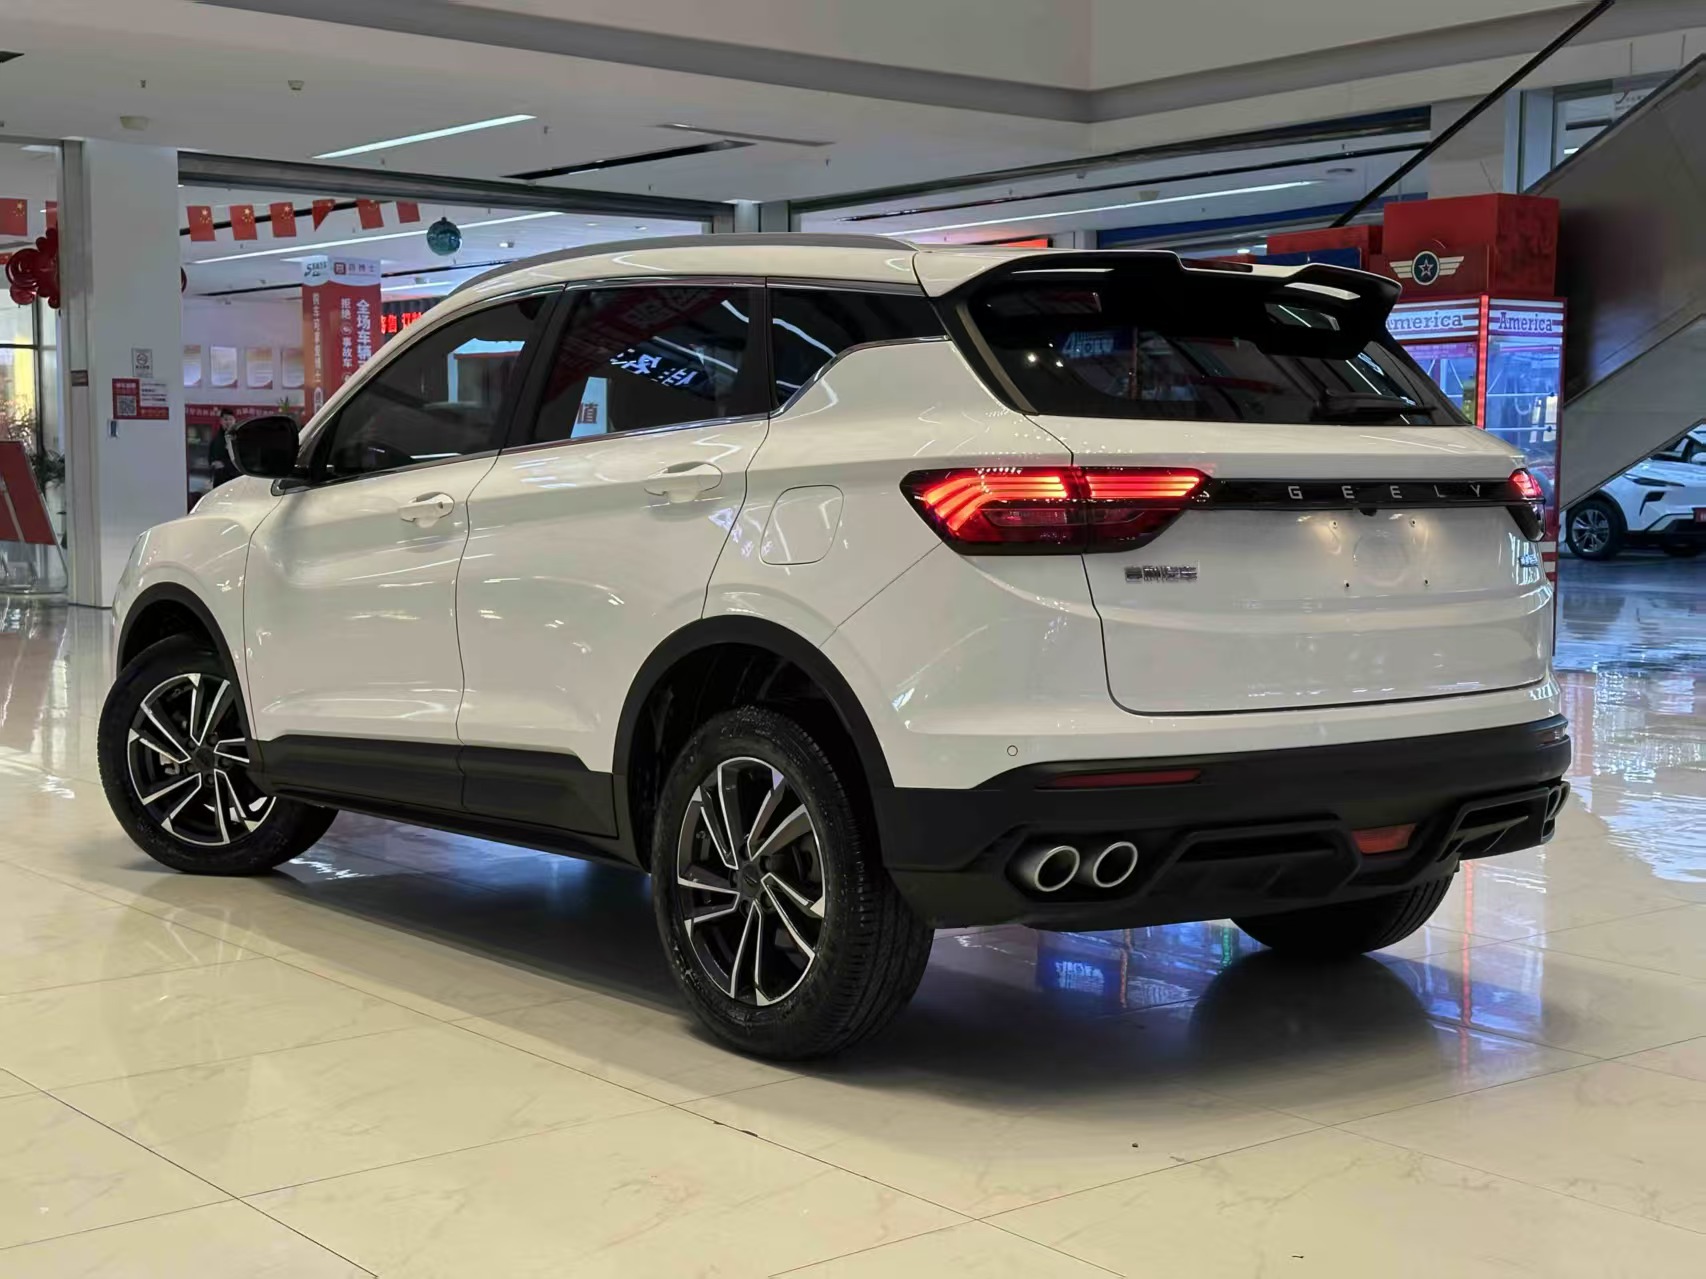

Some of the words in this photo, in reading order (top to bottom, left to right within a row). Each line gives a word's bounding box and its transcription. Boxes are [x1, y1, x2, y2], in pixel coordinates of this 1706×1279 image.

[1388, 311, 1463, 329] merica
[1498, 312, 1553, 331] America
[1287, 484, 1481, 499] GEELY
